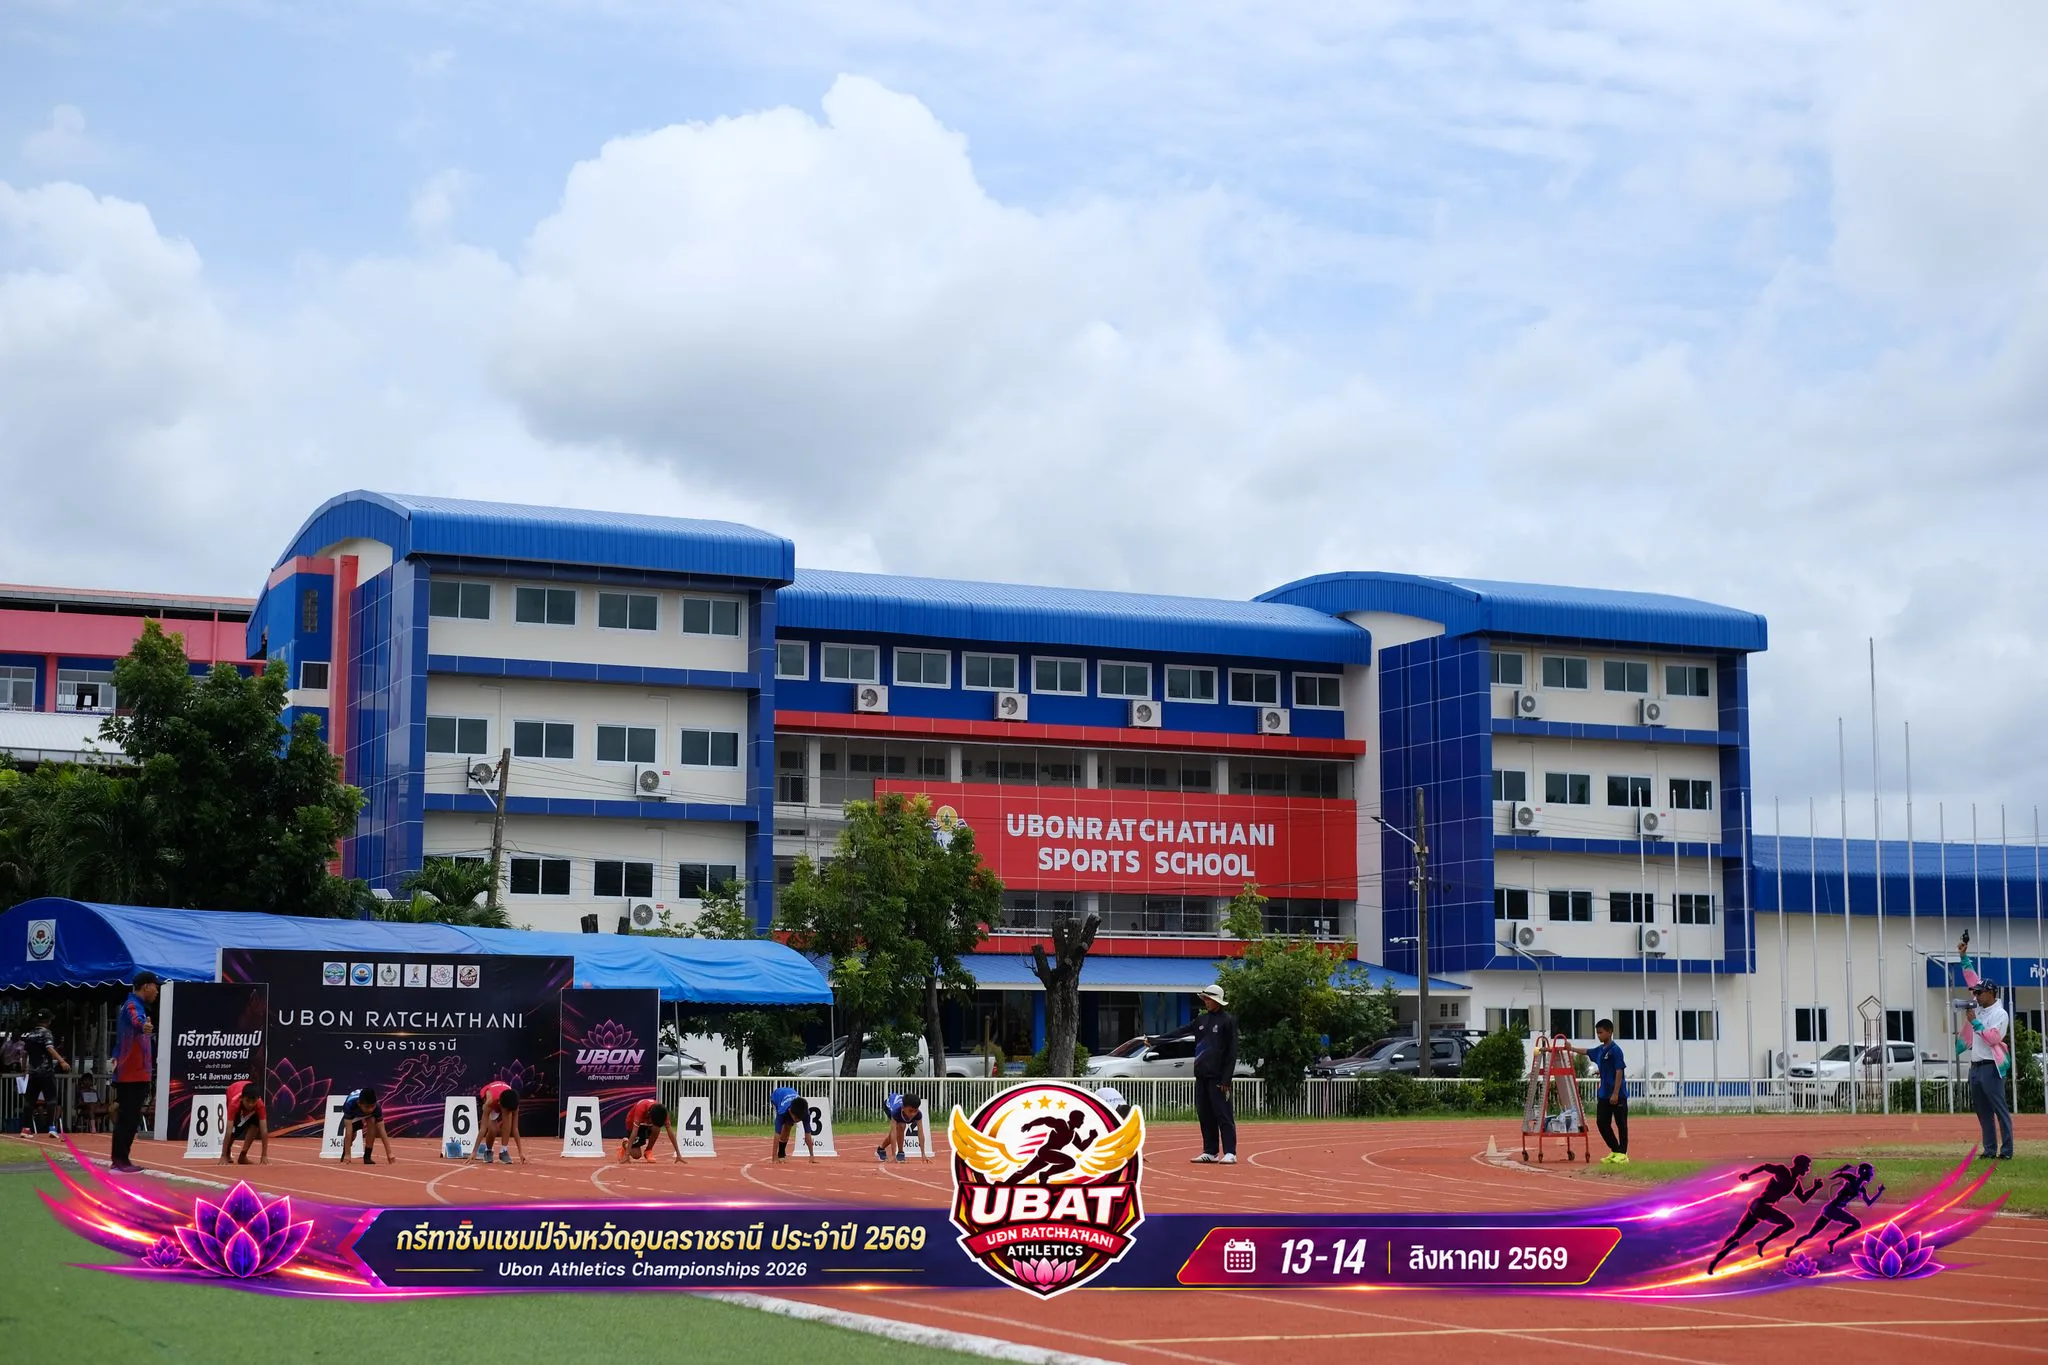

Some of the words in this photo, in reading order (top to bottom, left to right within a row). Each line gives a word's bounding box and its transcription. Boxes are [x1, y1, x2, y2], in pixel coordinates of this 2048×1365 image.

[1007, 814, 1276, 847] UBONRATCHATHANI
[1038, 847, 1140, 874] SPORTS
[1155, 852, 1255, 878] SCHOOL
[2030, 963, 2048, 978] ห้อ
[278, 1010, 353, 1027] UBON
[366, 1012, 523, 1029] RATCHATHANI
[187, 1047, 250, 1062] จ.อุบลราชธานี
[344, 1038, 457, 1054] จ.อุบลราชธานี
[575, 1049, 645, 1065] UBON
[187, 1073, 207, 1081] 12-14
[208, 1072, 232, 1081] สิงหาคม
[576, 1065, 641, 1074] ATHLETICS
[196, 1105, 208, 1136] 8
[217, 1103, 224, 1134] 8
[452, 1104, 470, 1135] 6
[574, 1106, 592, 1136] 5
[686, 1106, 703, 1136] 4
[808, 1106, 822, 1136] 3
